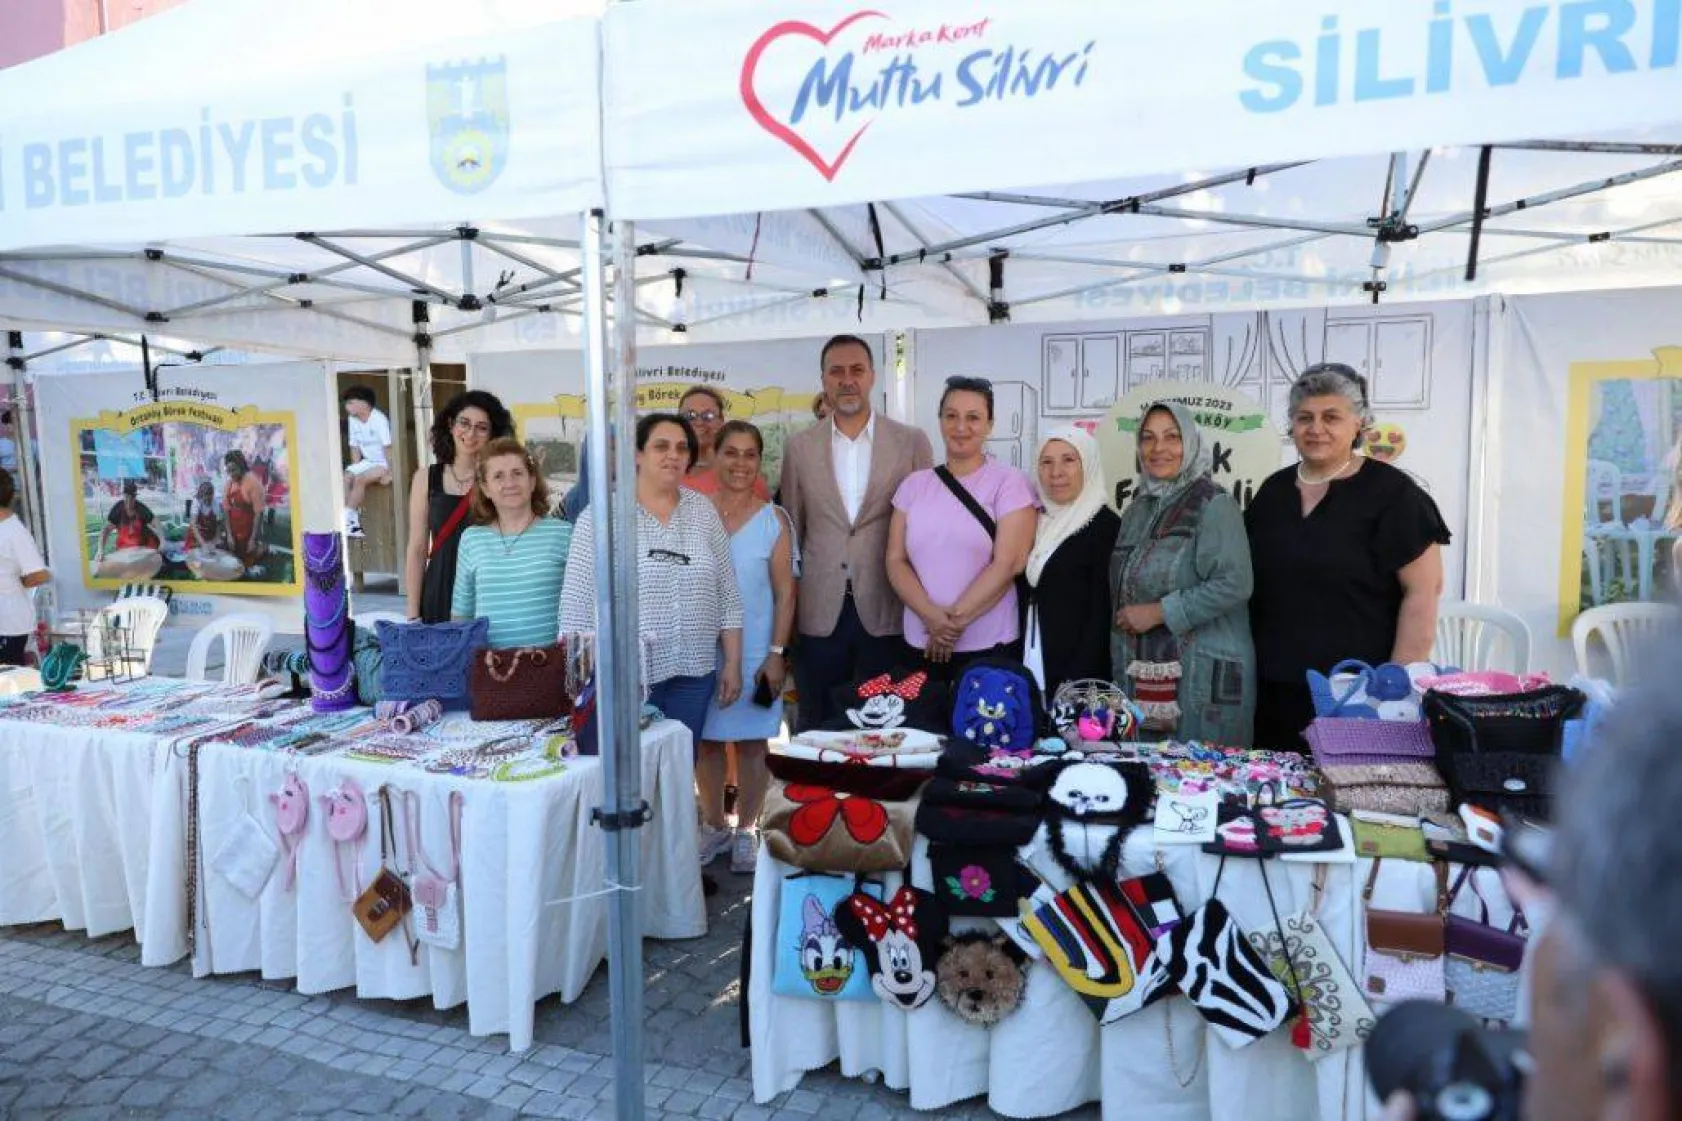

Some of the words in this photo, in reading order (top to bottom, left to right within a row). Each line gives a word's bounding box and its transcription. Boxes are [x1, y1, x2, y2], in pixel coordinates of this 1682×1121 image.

[863, 30, 932, 55] Marka
[937, 16, 994, 45] Kent
[955, 39, 1096, 107] Silivri
[23, 91, 359, 210] BELEDİYESİ
[667, 365, 726, 381] Belediyesi
[648, 388, 681, 401] Börek
